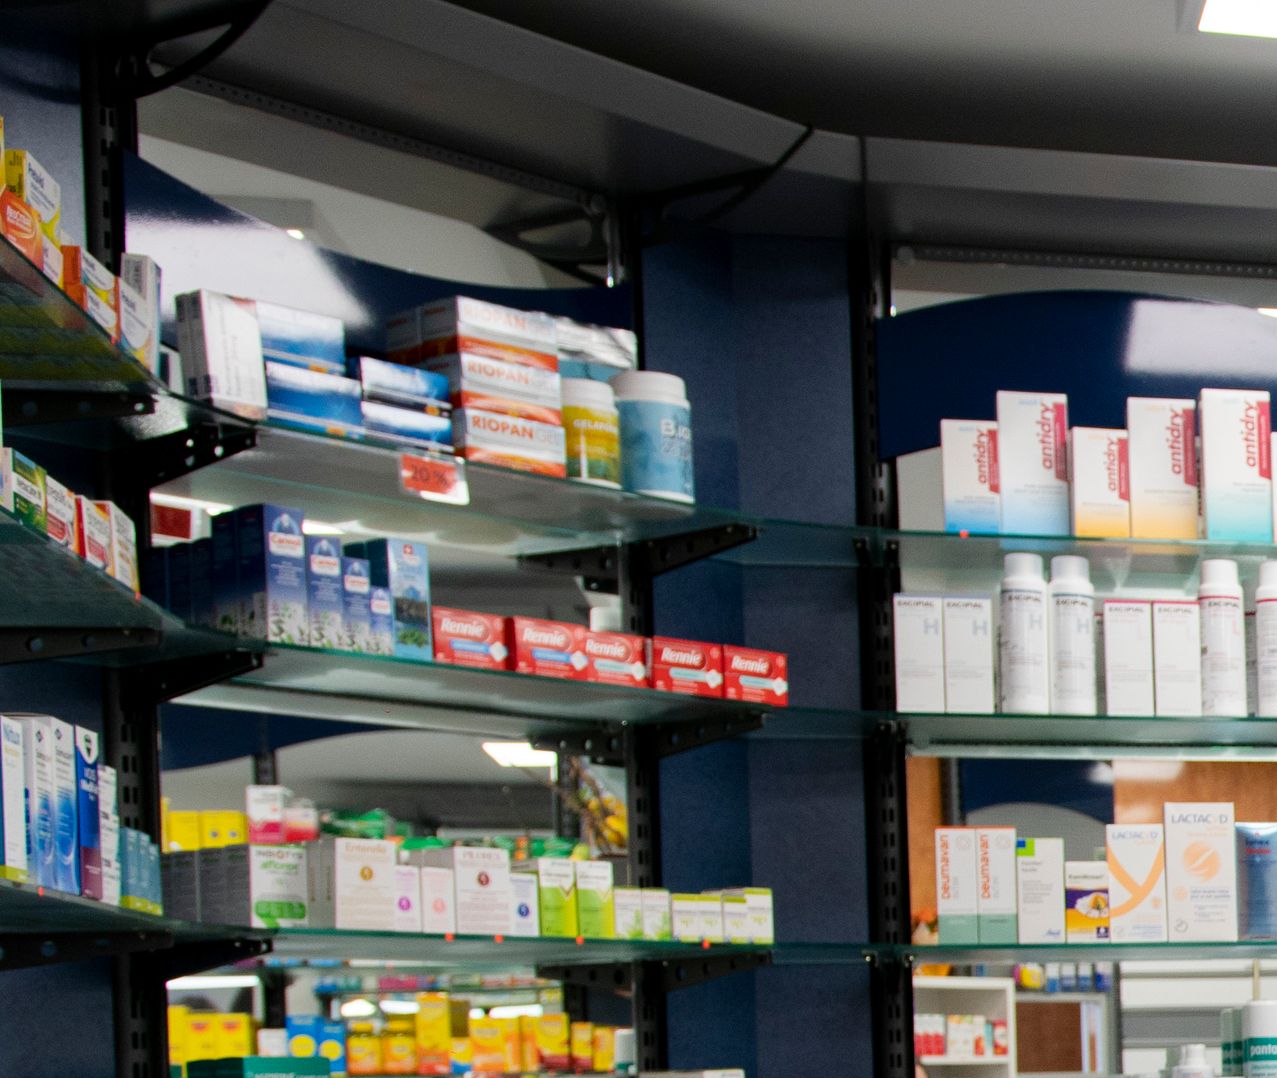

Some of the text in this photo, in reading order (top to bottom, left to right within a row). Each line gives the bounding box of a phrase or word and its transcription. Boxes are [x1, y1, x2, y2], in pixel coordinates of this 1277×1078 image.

[467, 360, 530, 384] RIOPAN
[472, 415, 534, 439] RIOPAN
[1036, 402, 1055, 470] antidry
[1243, 401, 1258, 468] antidry
[1171, 407, 1185, 474] antidry
[974, 428, 988, 485] antidry
[1105, 437, 1117, 491] antidry
[441, 616, 485, 636] Rennie
[522, 628, 566, 647] Rennie
[585, 638, 626, 658] Rennie
[661, 647, 702, 665] Rennie
[732, 654, 769, 674] Rennie
[1171, 814, 1229, 825] LACTACD
[1111, 831, 1158, 841] LACTACD
